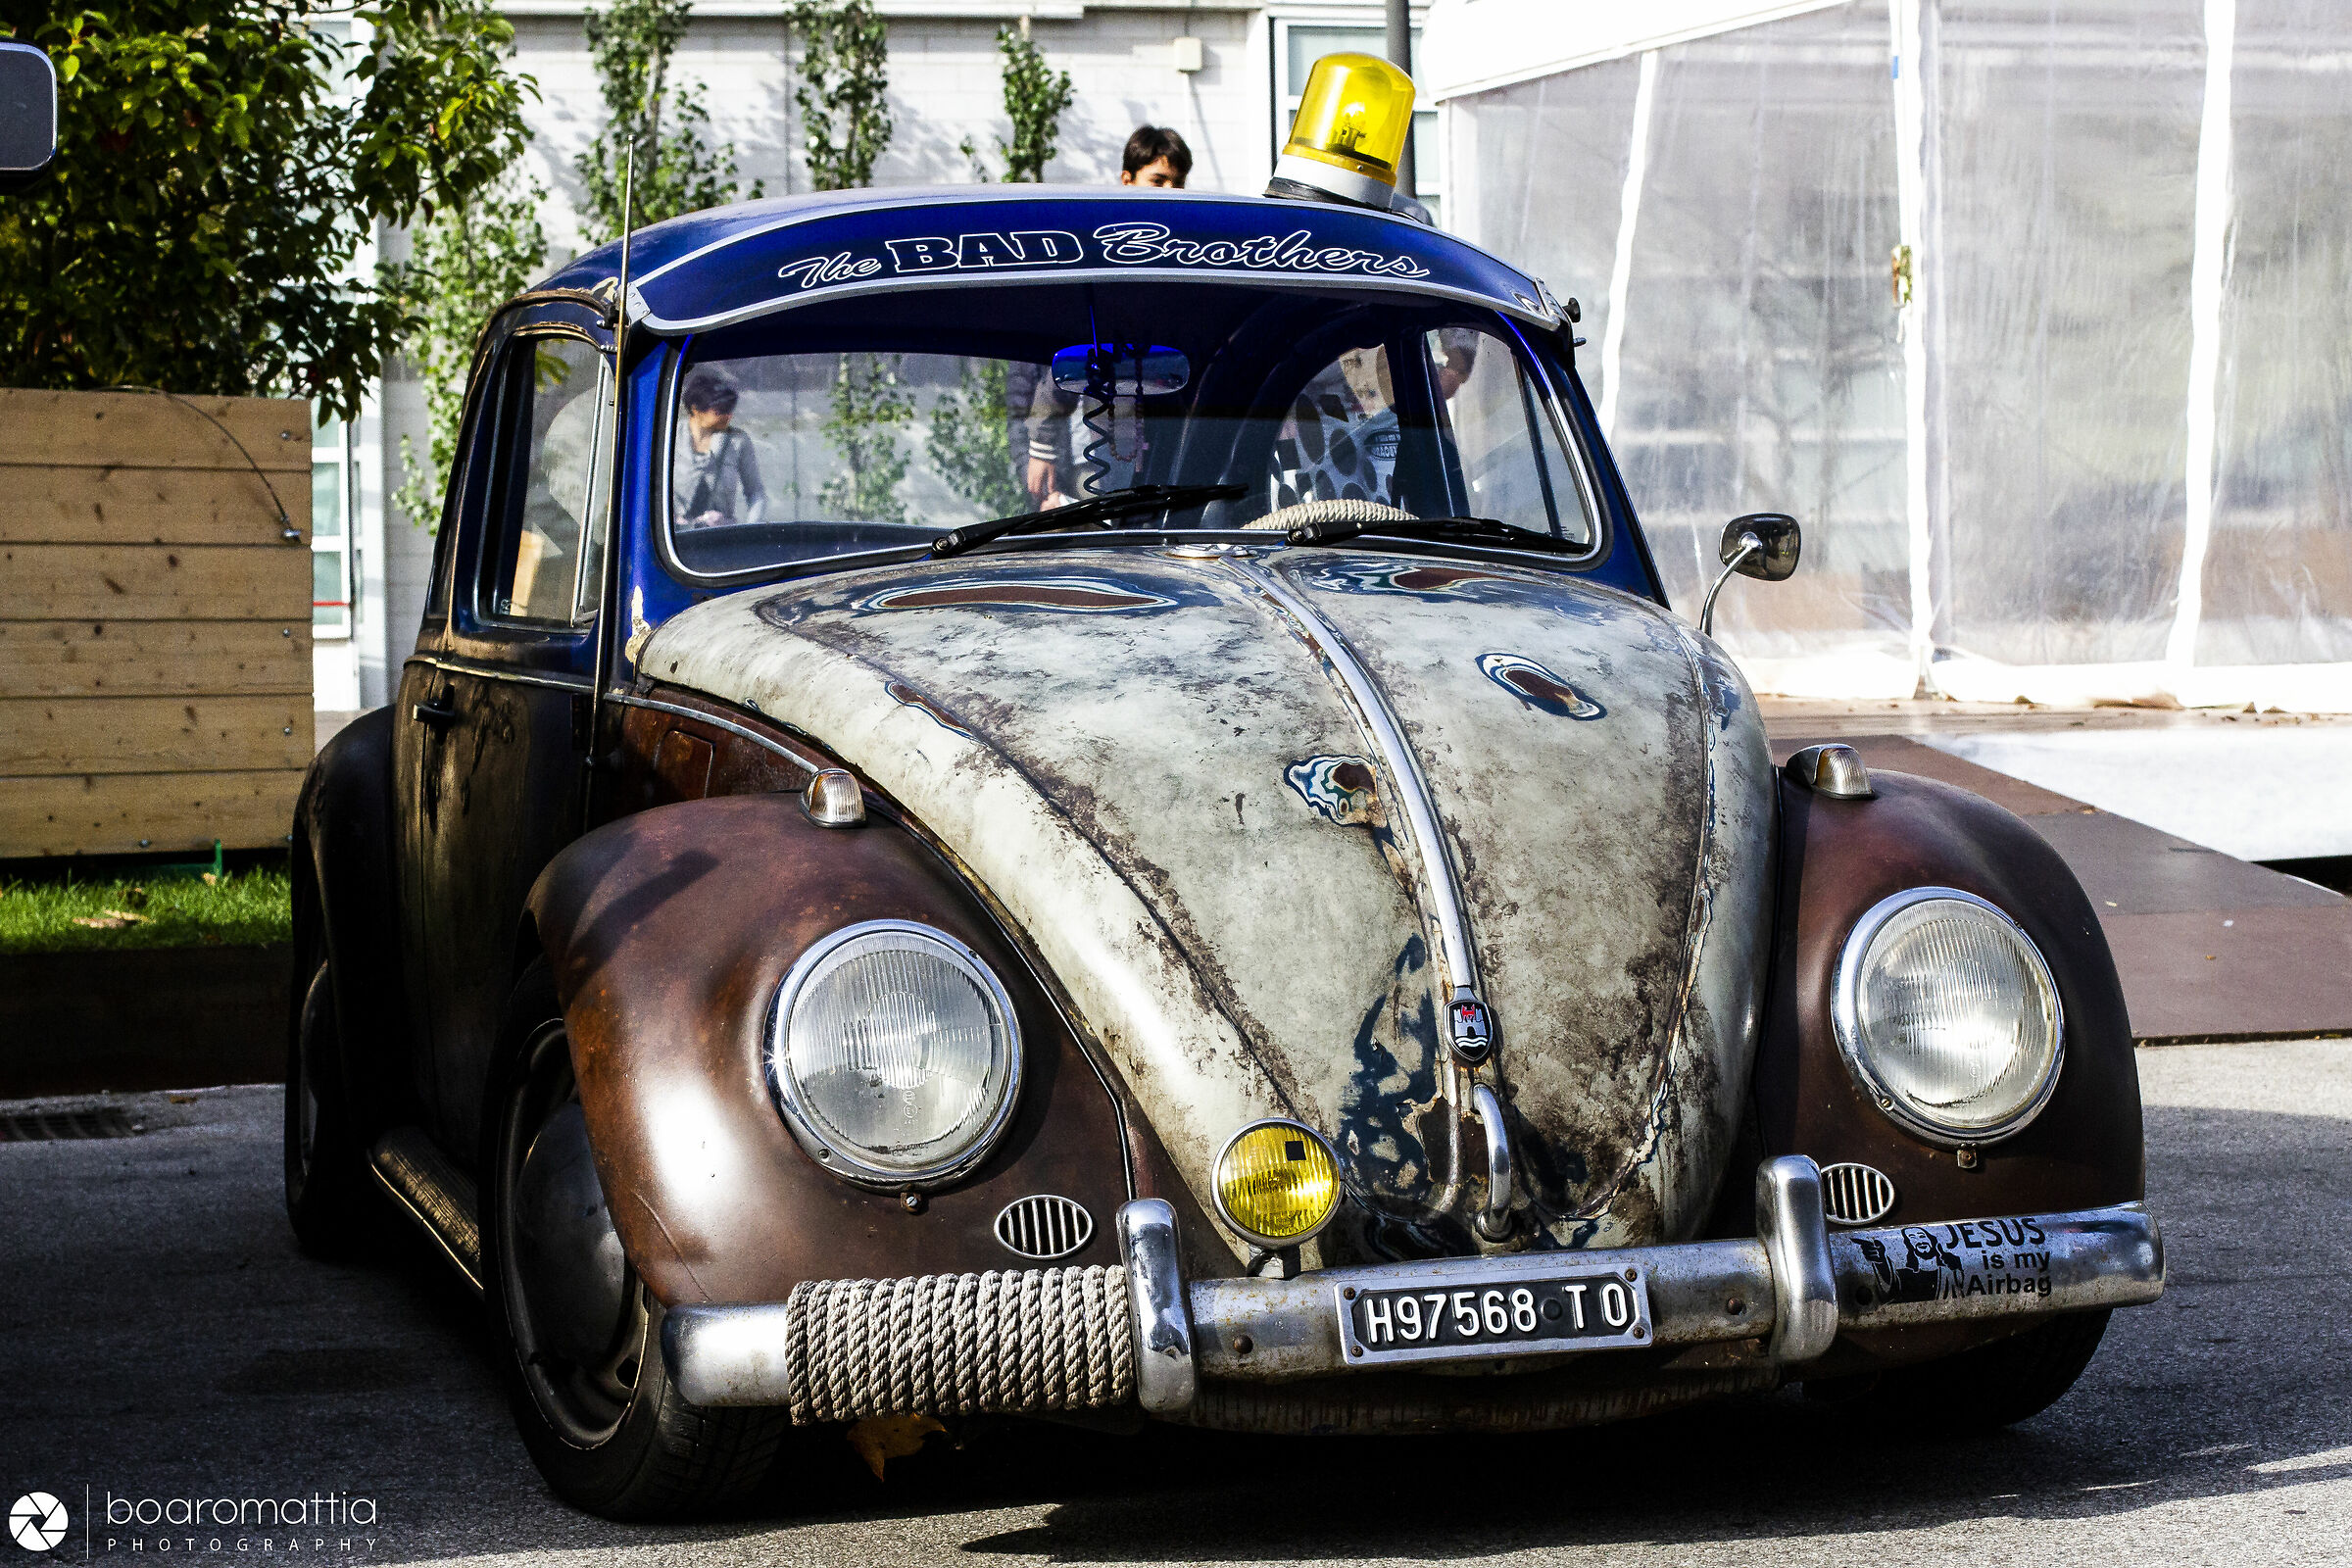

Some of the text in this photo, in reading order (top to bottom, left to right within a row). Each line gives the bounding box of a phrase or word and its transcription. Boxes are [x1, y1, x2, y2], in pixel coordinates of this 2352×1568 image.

[777, 221, 1431, 289] The BAD Brothers
[1944, 1217, 2046, 1250] JESUS
[1982, 1250, 2050, 1273] is my
[1966, 1274, 2052, 1298] Airbag
[1366, 1287, 1538, 1344] H97568
